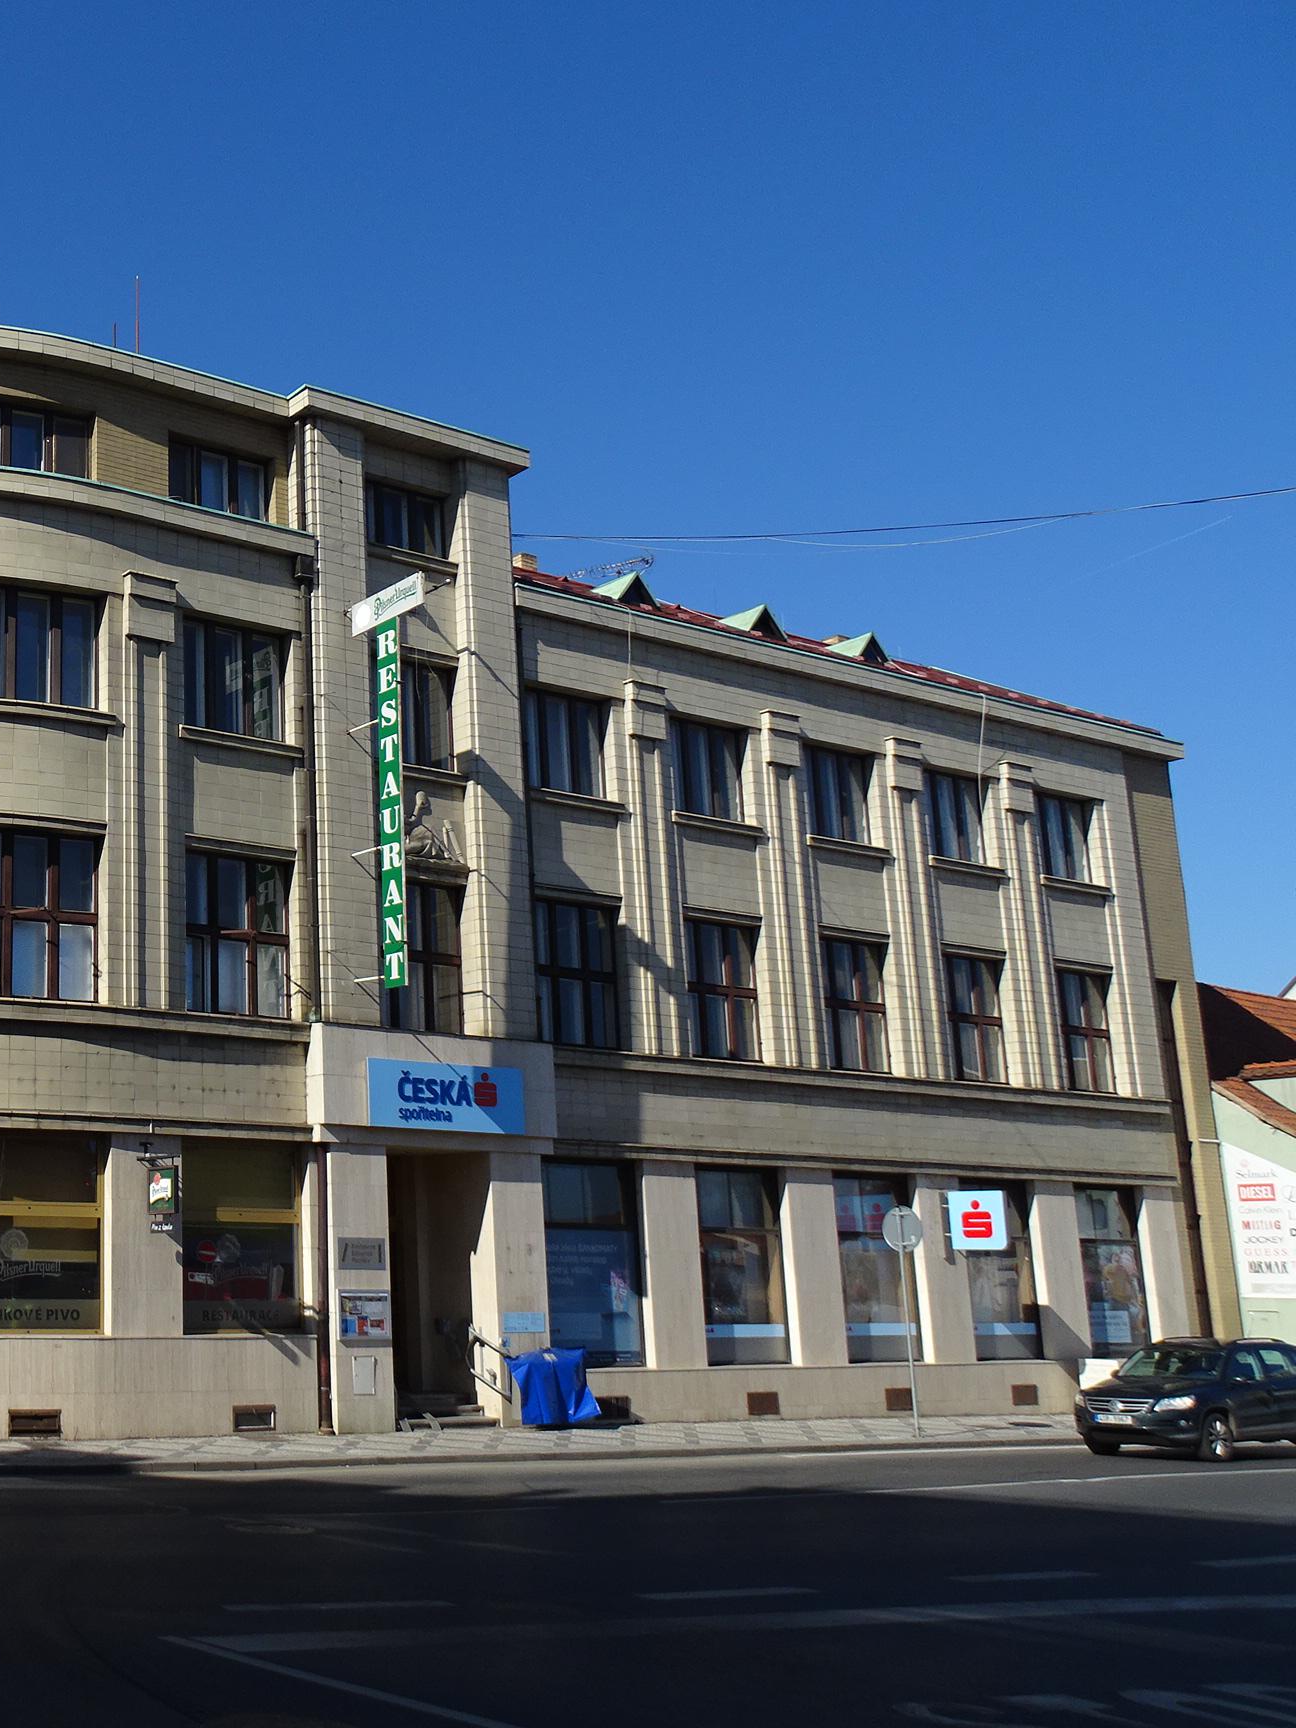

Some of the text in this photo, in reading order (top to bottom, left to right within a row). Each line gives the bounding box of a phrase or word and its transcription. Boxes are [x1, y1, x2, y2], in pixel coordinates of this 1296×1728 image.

[376, 628, 404, 981] RESTAURANT
[397, 1070, 473, 1107] ČESKÁ
[398, 1106, 453, 1123] spořitelna
[1240, 1186, 1274, 1199] DIESEL
[1244, 1248, 1289, 1257] GUESS
[27, 1258, 61, 1278] Urquell
[45, 1308, 81, 1320] PIVO
